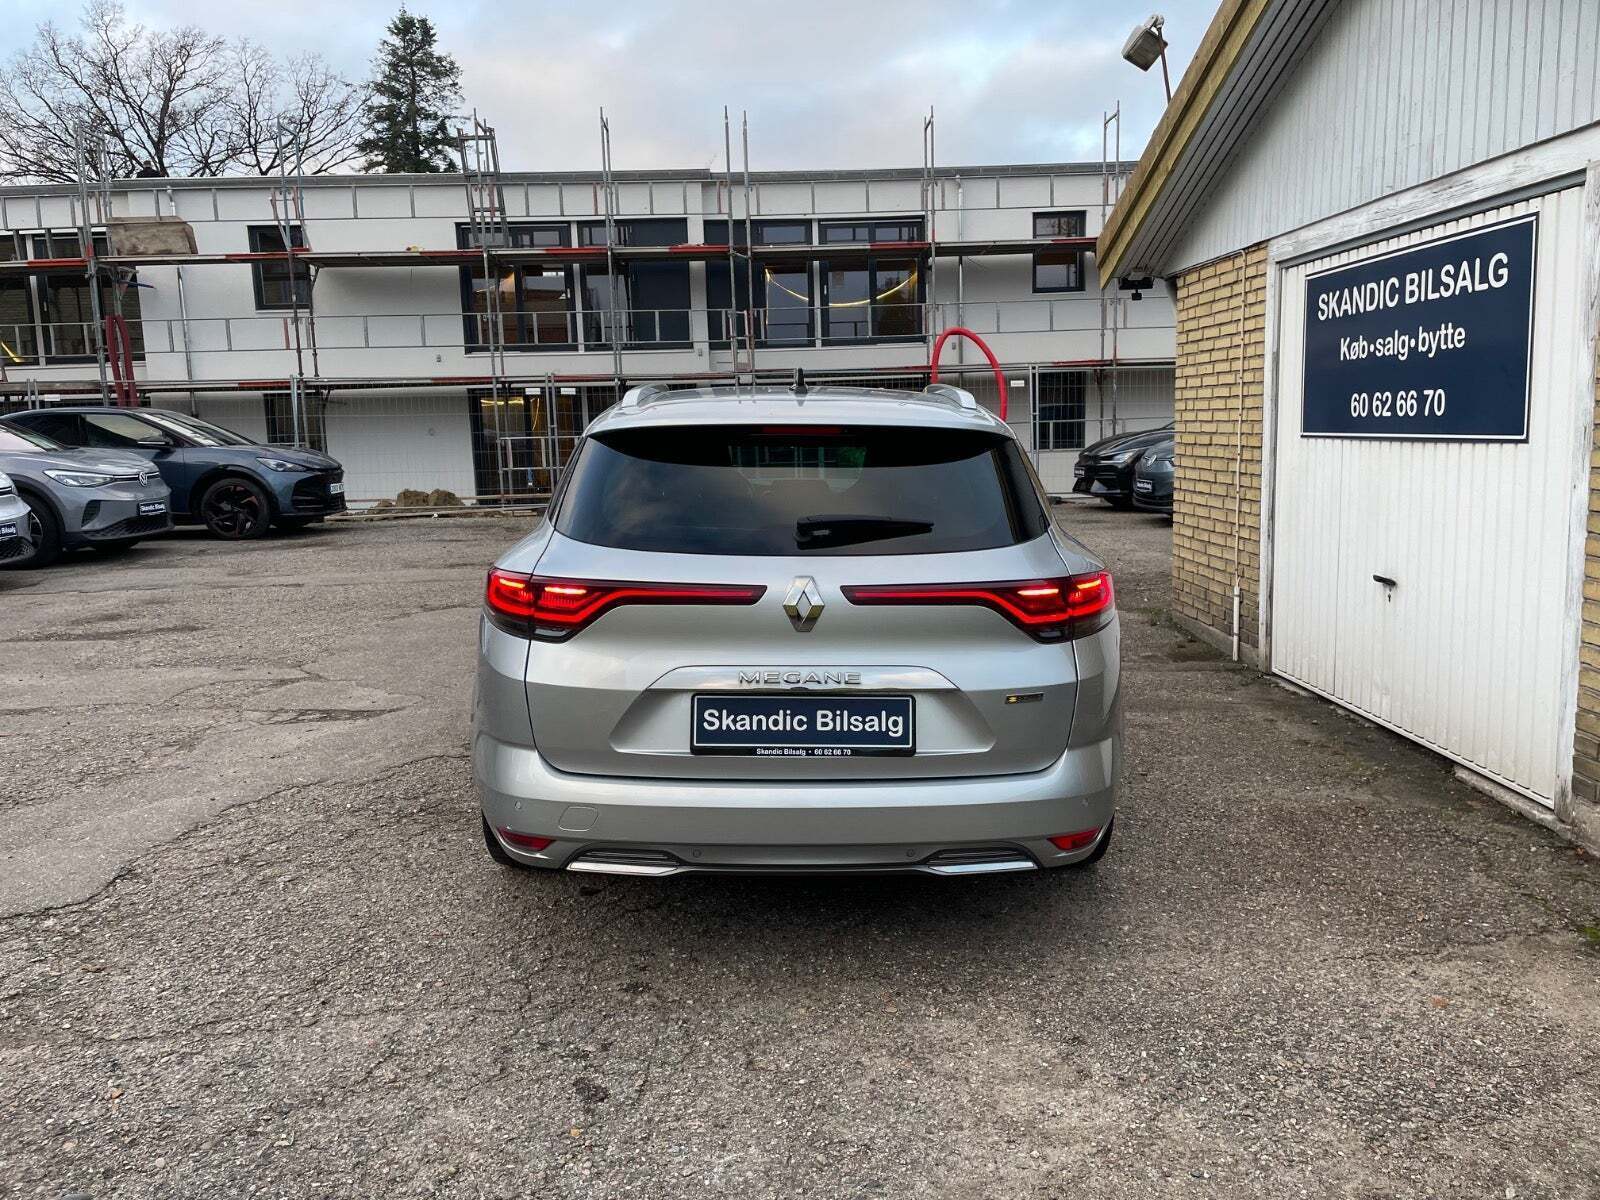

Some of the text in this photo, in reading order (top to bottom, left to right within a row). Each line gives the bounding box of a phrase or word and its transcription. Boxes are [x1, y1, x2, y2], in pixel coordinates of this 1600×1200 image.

[1317, 252, 1509, 321] SKANDIC BILSALG
[1351, 388, 1446, 418] 60 62 66 70
[738, 671, 862, 686] MEGANE
[703, 709, 904, 738] Skandic Bilsalg
[784, 748, 806, 757] Bilsalg
[814, 748, 823, 756] 60
[824, 748, 833, 756] 62
[833, 748, 842, 756] 66
